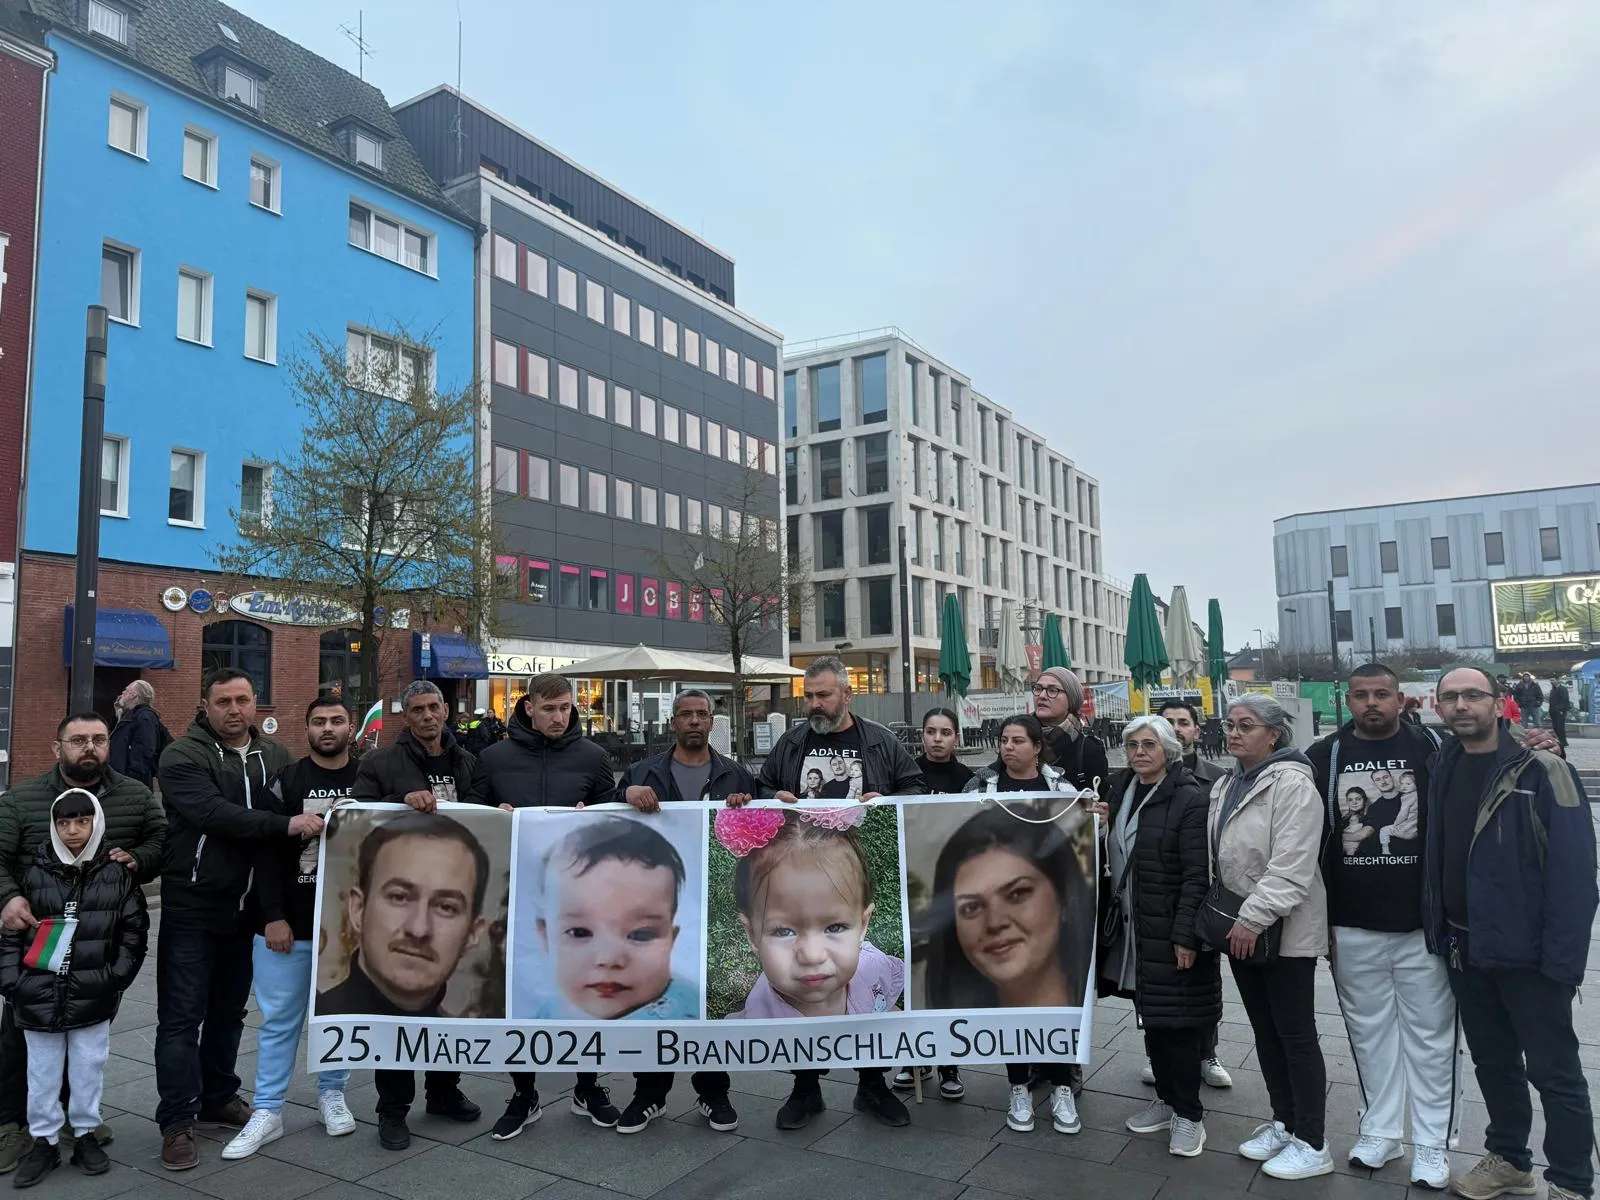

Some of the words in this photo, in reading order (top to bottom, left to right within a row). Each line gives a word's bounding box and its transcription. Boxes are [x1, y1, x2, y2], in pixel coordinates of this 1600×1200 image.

[1500, 623, 1528, 634] LIVE
[1529, 621, 1566, 633] WHAT
[1501, 633, 1528, 645] YOU
[1528, 631, 1580, 644] BELIEVE
[809, 748, 858, 758] ADALET
[1344, 760, 1407, 773] ADALET
[308, 787, 353, 798] ADALE
[1343, 855, 1418, 865] GERECHTIGKEIT
[319, 1025, 381, 1064] 25.
[504, 1029, 606, 1066] 2024
